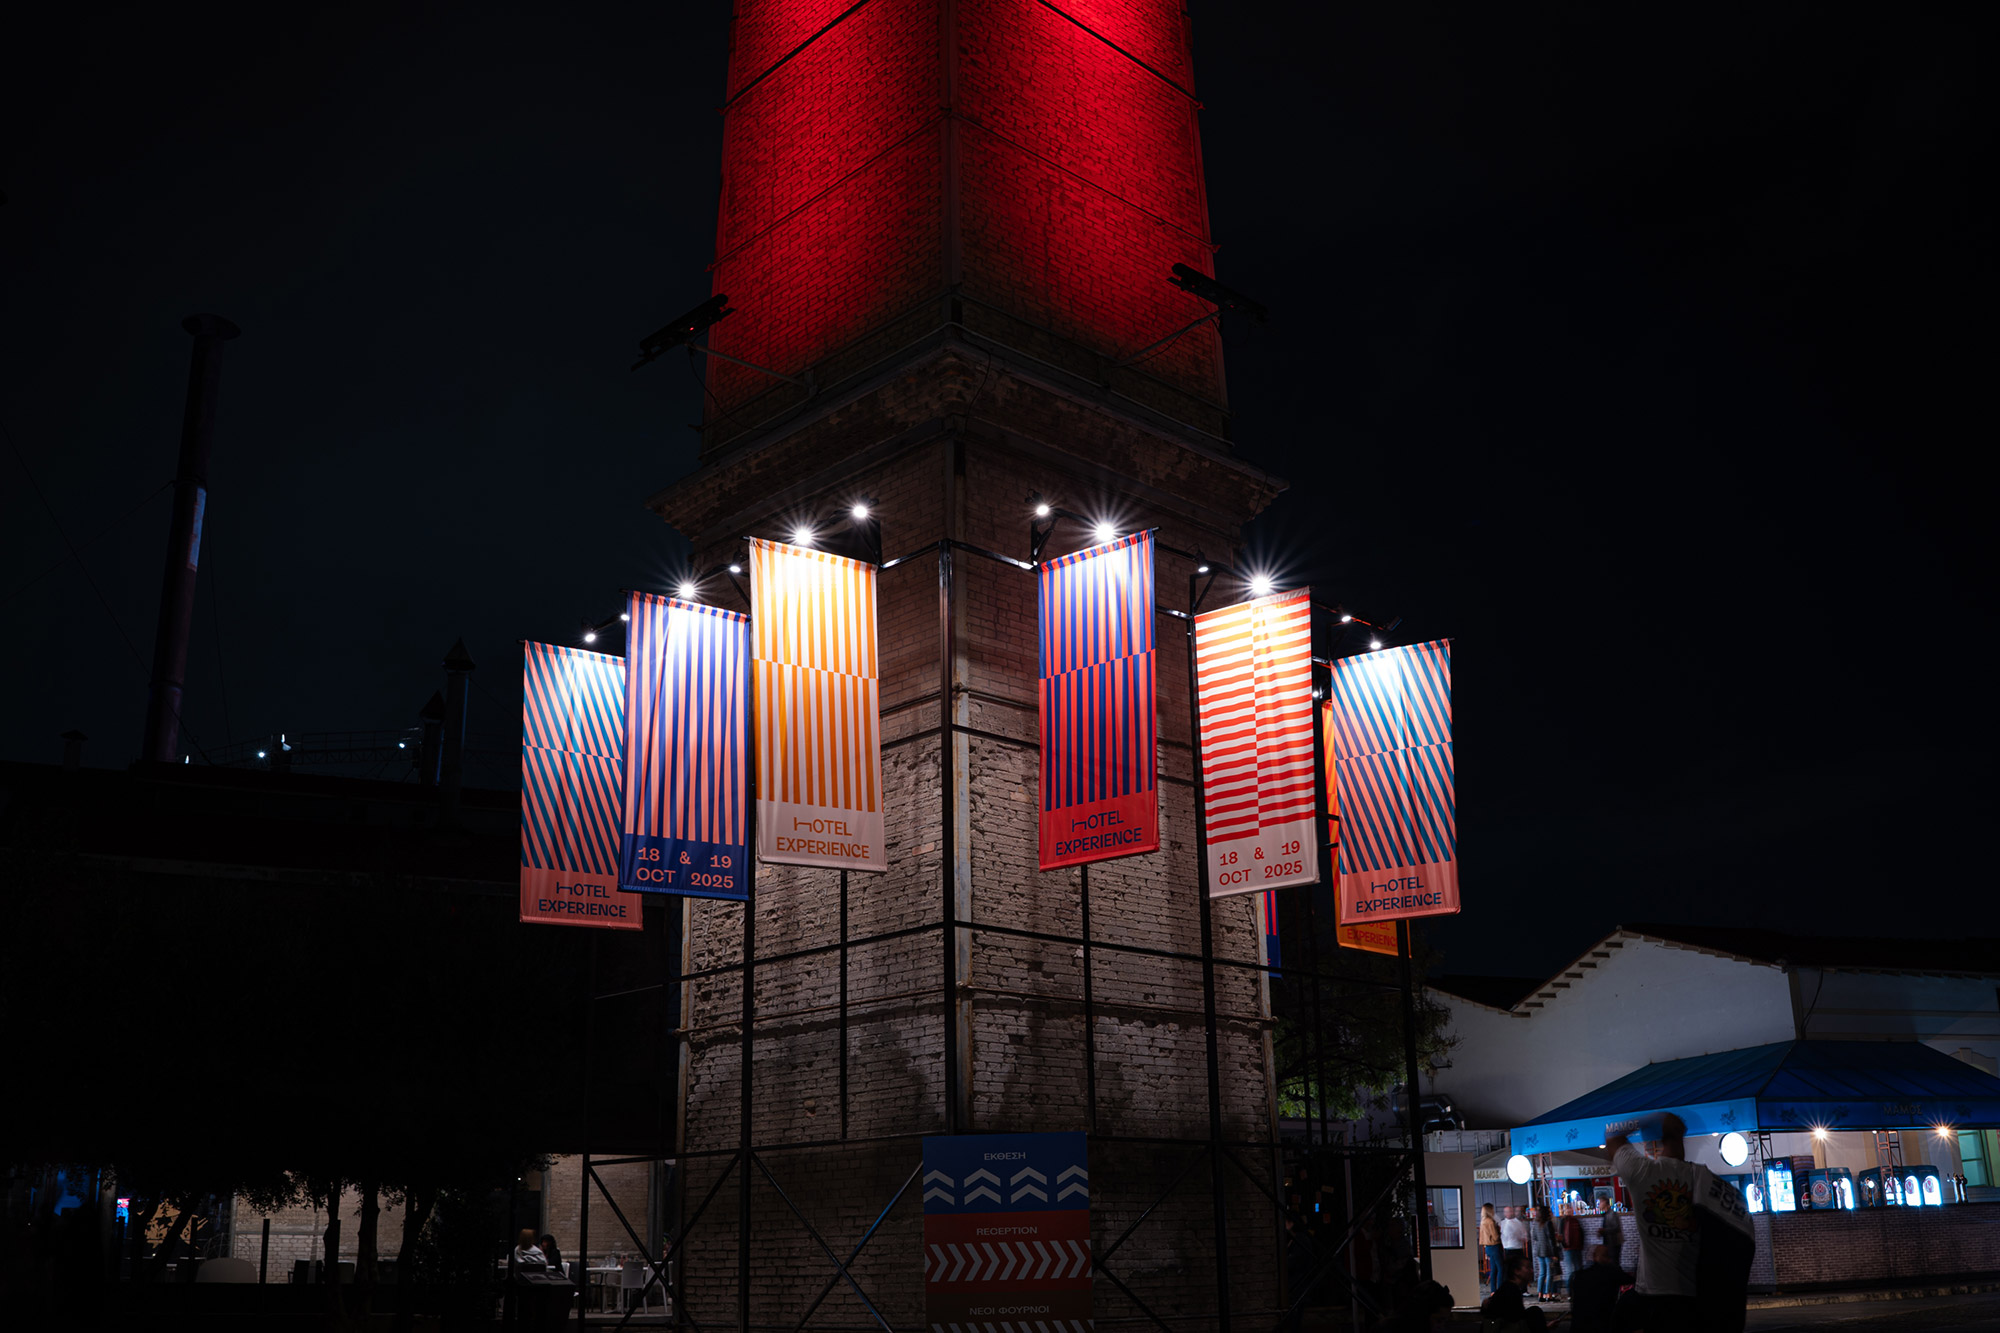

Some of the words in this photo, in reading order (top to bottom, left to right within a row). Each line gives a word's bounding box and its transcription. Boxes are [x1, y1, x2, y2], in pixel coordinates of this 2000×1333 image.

[794, 816, 852, 837] HOTEL
[1071, 810, 1124, 833] HOTEL
[777, 837, 870, 859] EXPERIENCE
[1056, 827, 1142, 856] EXPERIENCE
[637, 846, 660, 862] 18
[679, 851, 691, 865] &
[710, 854, 732, 869] 19
[1220, 853, 1238, 867] 18
[1254, 847, 1264, 860] &
[1281, 840, 1300, 855] 19
[636, 867, 677, 884] OCT
[690, 872, 734, 889] 2025
[1219, 868, 1250, 886] OCT
[1264, 860, 1303, 879] 2025
[556, 881, 610, 899] HOTEL
[1371, 877, 1424, 894] HOTEL
[538, 899, 627, 918] EXPERIENCE
[1356, 893, 1442, 913] EXPERIENCE
[1347, 928, 1397, 947] EXPERIENC
[984, 1152, 1026, 1161] ΕΚΘΕΣΗ
[976, 1226, 1038, 1236] RECEPTION
[969, 1306, 995, 1316] ΝΕΟΙ
[998, 1305, 1050, 1315] ΦΟΥΡΝΟΙ
